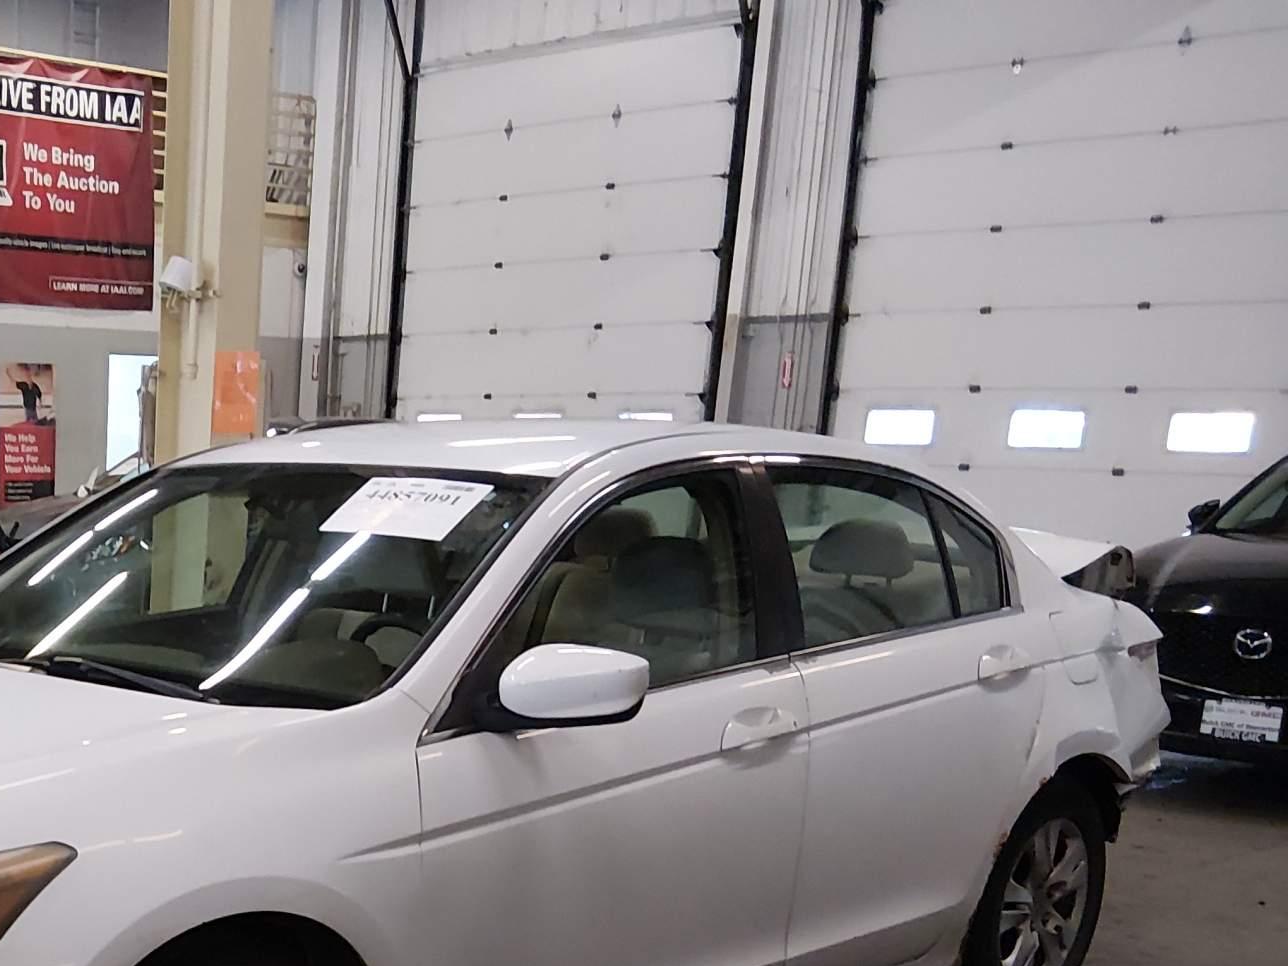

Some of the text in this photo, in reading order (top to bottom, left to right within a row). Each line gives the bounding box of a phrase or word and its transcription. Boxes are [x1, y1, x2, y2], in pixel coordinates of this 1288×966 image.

[40, 84, 99, 120] FROM
[105, 96, 143, 125] IAA
[23, 142, 95, 170] We Bring
[23, 167, 120, 195] The Auction
[23, 190, 75, 214] To You
